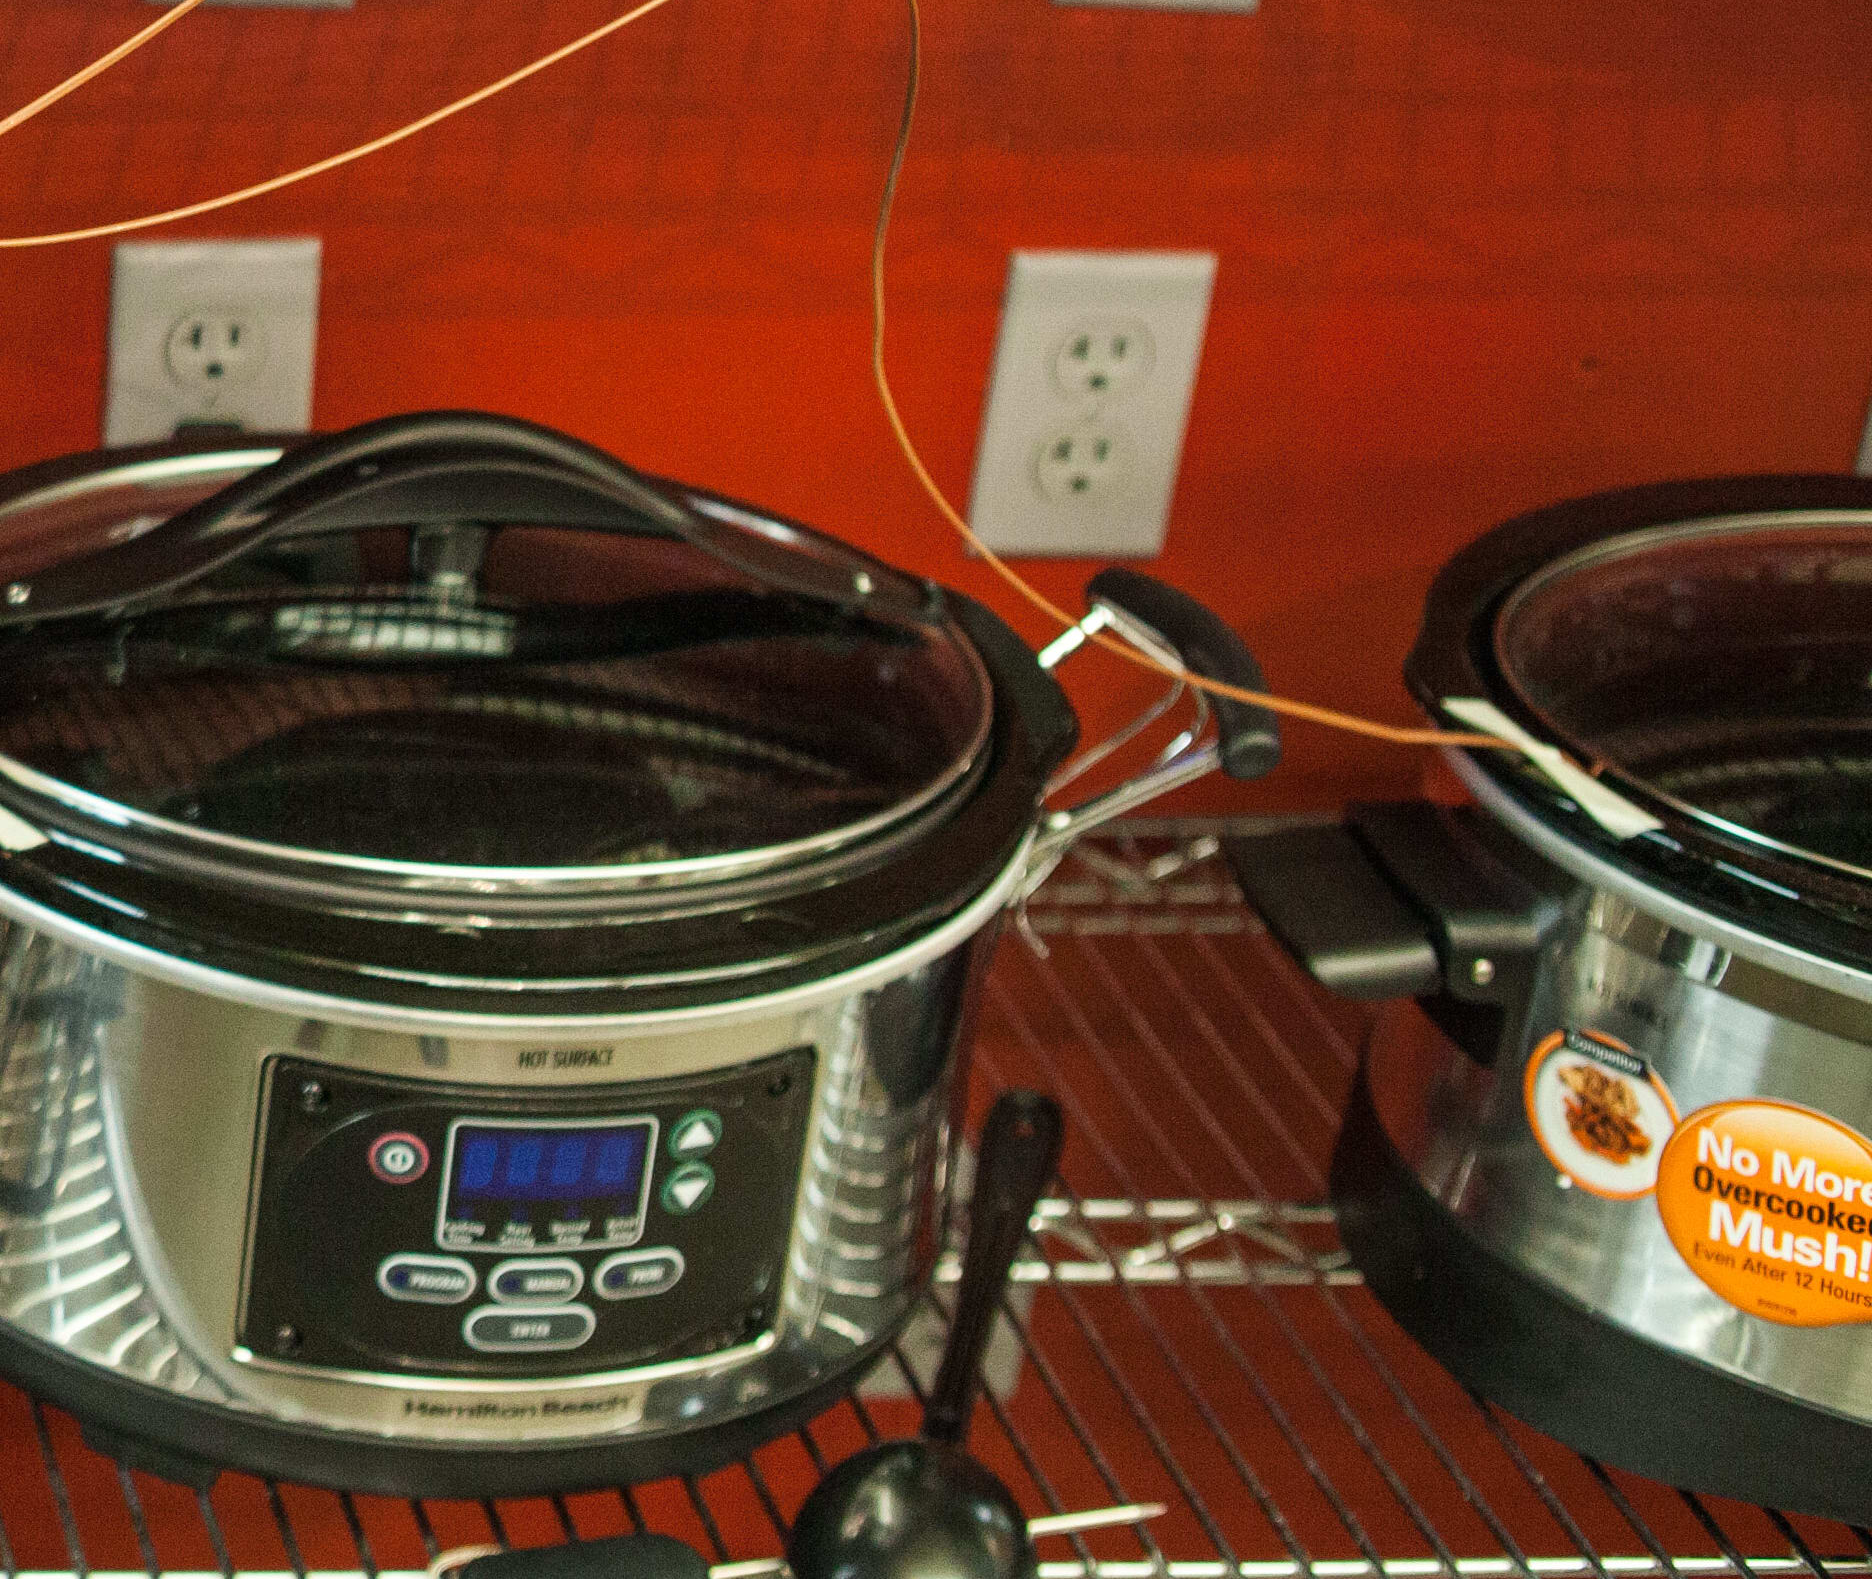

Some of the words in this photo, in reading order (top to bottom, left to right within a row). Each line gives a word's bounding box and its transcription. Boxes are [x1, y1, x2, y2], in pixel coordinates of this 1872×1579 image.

[519, 1050, 549, 1069] HOT
[553, 1048, 615, 1069] SURFACE
[1570, 1034, 1642, 1073] Competitor
[1697, 1127, 1760, 1177] No
[1693, 1165, 1872, 1237] Overcooke
[1708, 1199, 1872, 1283] Mush!
[1694, 1241, 1736, 1269] Even
[1742, 1257, 1787, 1283] After
[1795, 1271, 1813, 1290] 12
[1820, 1278, 1872, 1308] Hours
[404, 1397, 538, 1418] Hamilton
[541, 1392, 632, 1415] Beach
